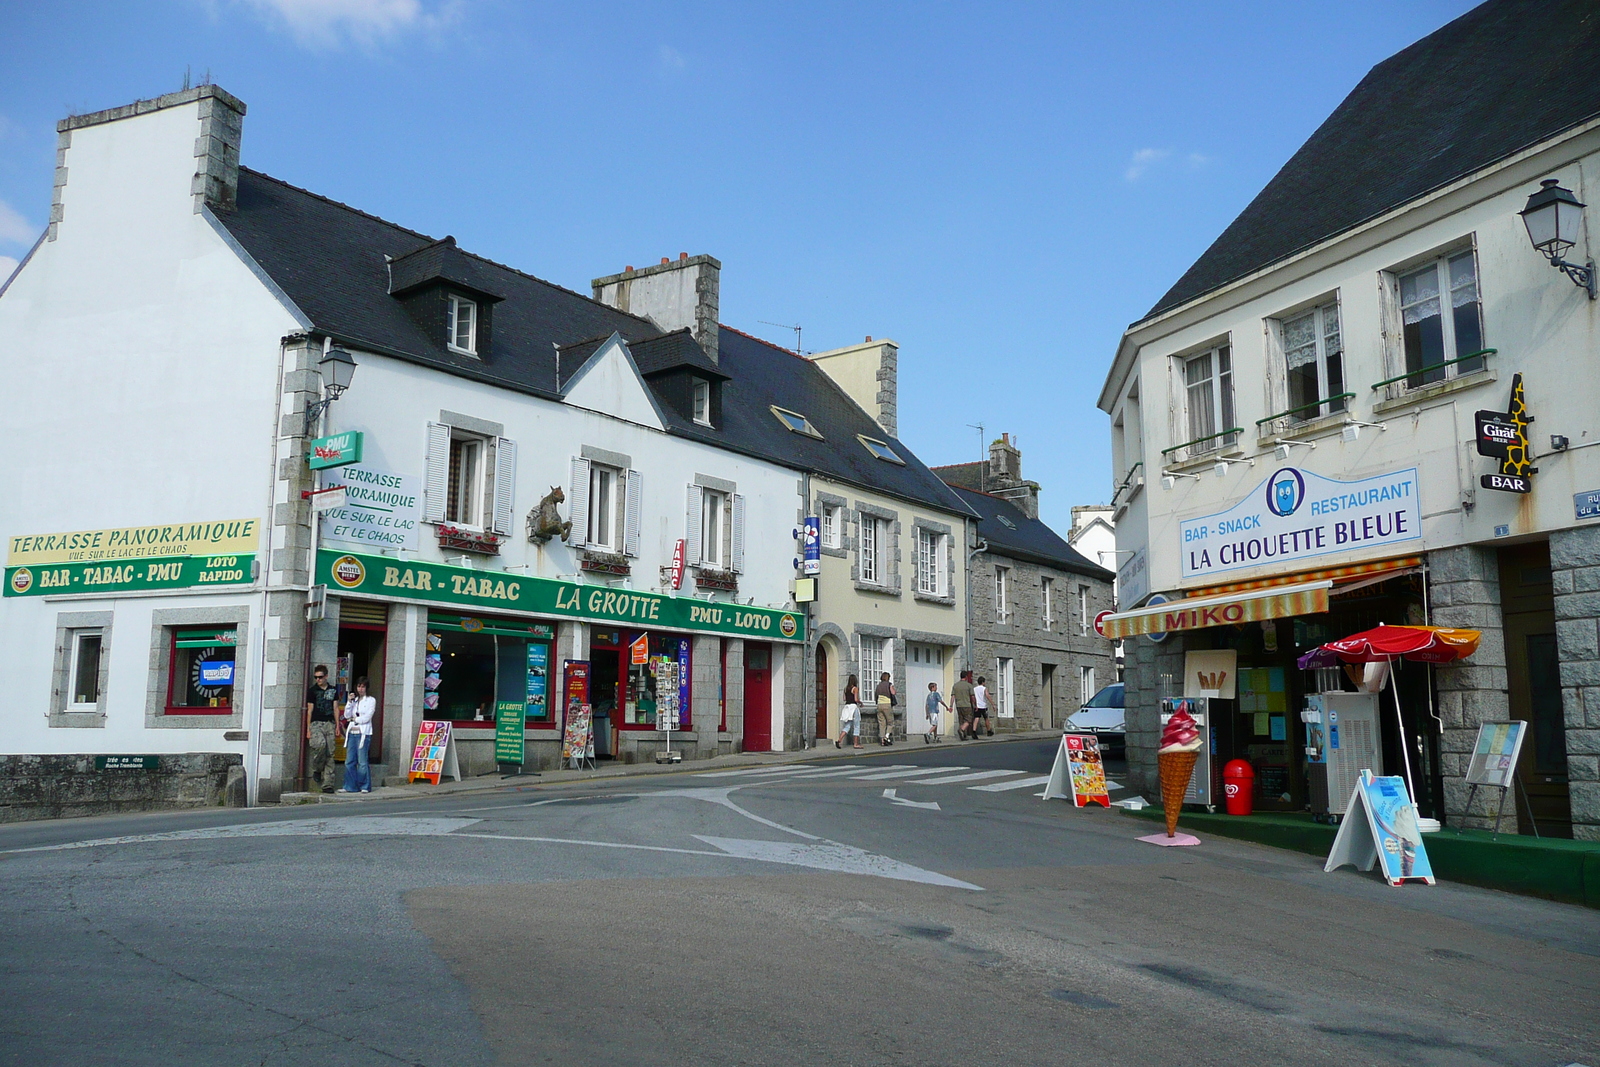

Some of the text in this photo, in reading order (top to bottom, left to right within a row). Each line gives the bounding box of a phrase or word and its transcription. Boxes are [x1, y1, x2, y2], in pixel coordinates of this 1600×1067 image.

[326, 435, 350, 450] PMU
[343, 467, 402, 489] TERRASSE
[1491, 476, 1525, 491] BAR
[1310, 481, 1412, 516] RESTAURANT
[1587, 494, 1600, 504] RU
[325, 507, 415, 530] VUE SUR LE LAC
[1580, 506, 1591, 515] du
[14, 521, 254, 553] TERRASSE PANORAMIQUE
[333, 525, 405, 544] ET LE CHAOS
[1185, 526, 1208, 543] BAR
[1218, 514, 1261, 536] SNACK
[1190, 510, 1408, 571] LA CHOUETTE BLEUE
[69, 544, 188, 560] VUE SUR LE LAC ET LE CHAOS
[206, 556, 237, 568] LOTO
[39, 569, 70, 588] BAR
[83, 565, 134, 585] TABAC
[146, 563, 183, 582] PMU
[198, 569, 243, 582] RAPIDO
[338, 565, 360, 574] AMSTEL
[671, 541, 682, 588] TABAC
[383, 566, 432, 591] BAR
[451, 575, 521, 601] TABAC
[555, 586, 661, 620] LA GROTTE
[690, 605, 722, 624] PMU
[735, 612, 771, 630] LOTO
[1165, 604, 1244, 630] MIKO
[506, 703, 523, 711] GROTTE
